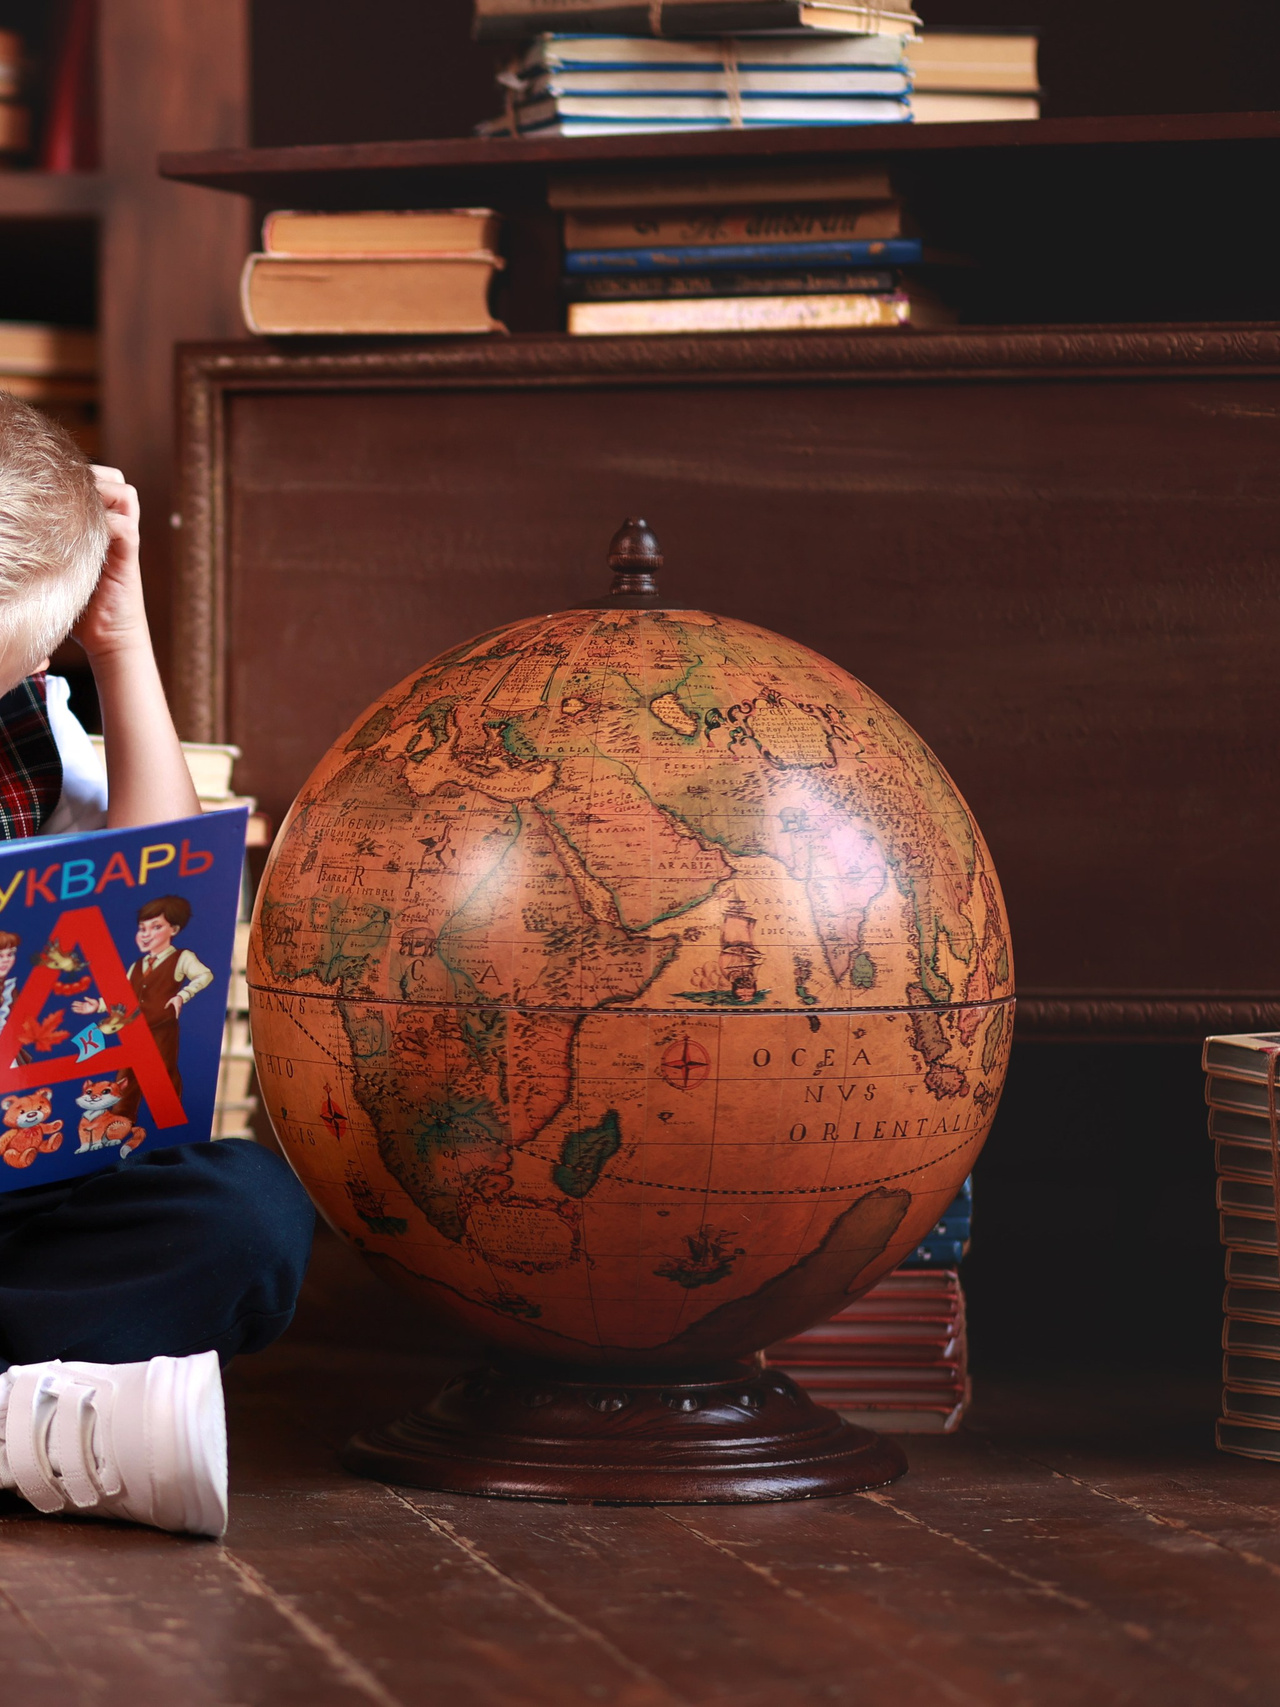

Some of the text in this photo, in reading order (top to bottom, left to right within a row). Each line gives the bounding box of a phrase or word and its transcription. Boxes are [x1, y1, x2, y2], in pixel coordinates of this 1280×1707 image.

[657, 862, 715, 871] ARABIA
[81, 1029, 100, 1055] К
[789, 1112, 983, 1143] ORIENTALIS
